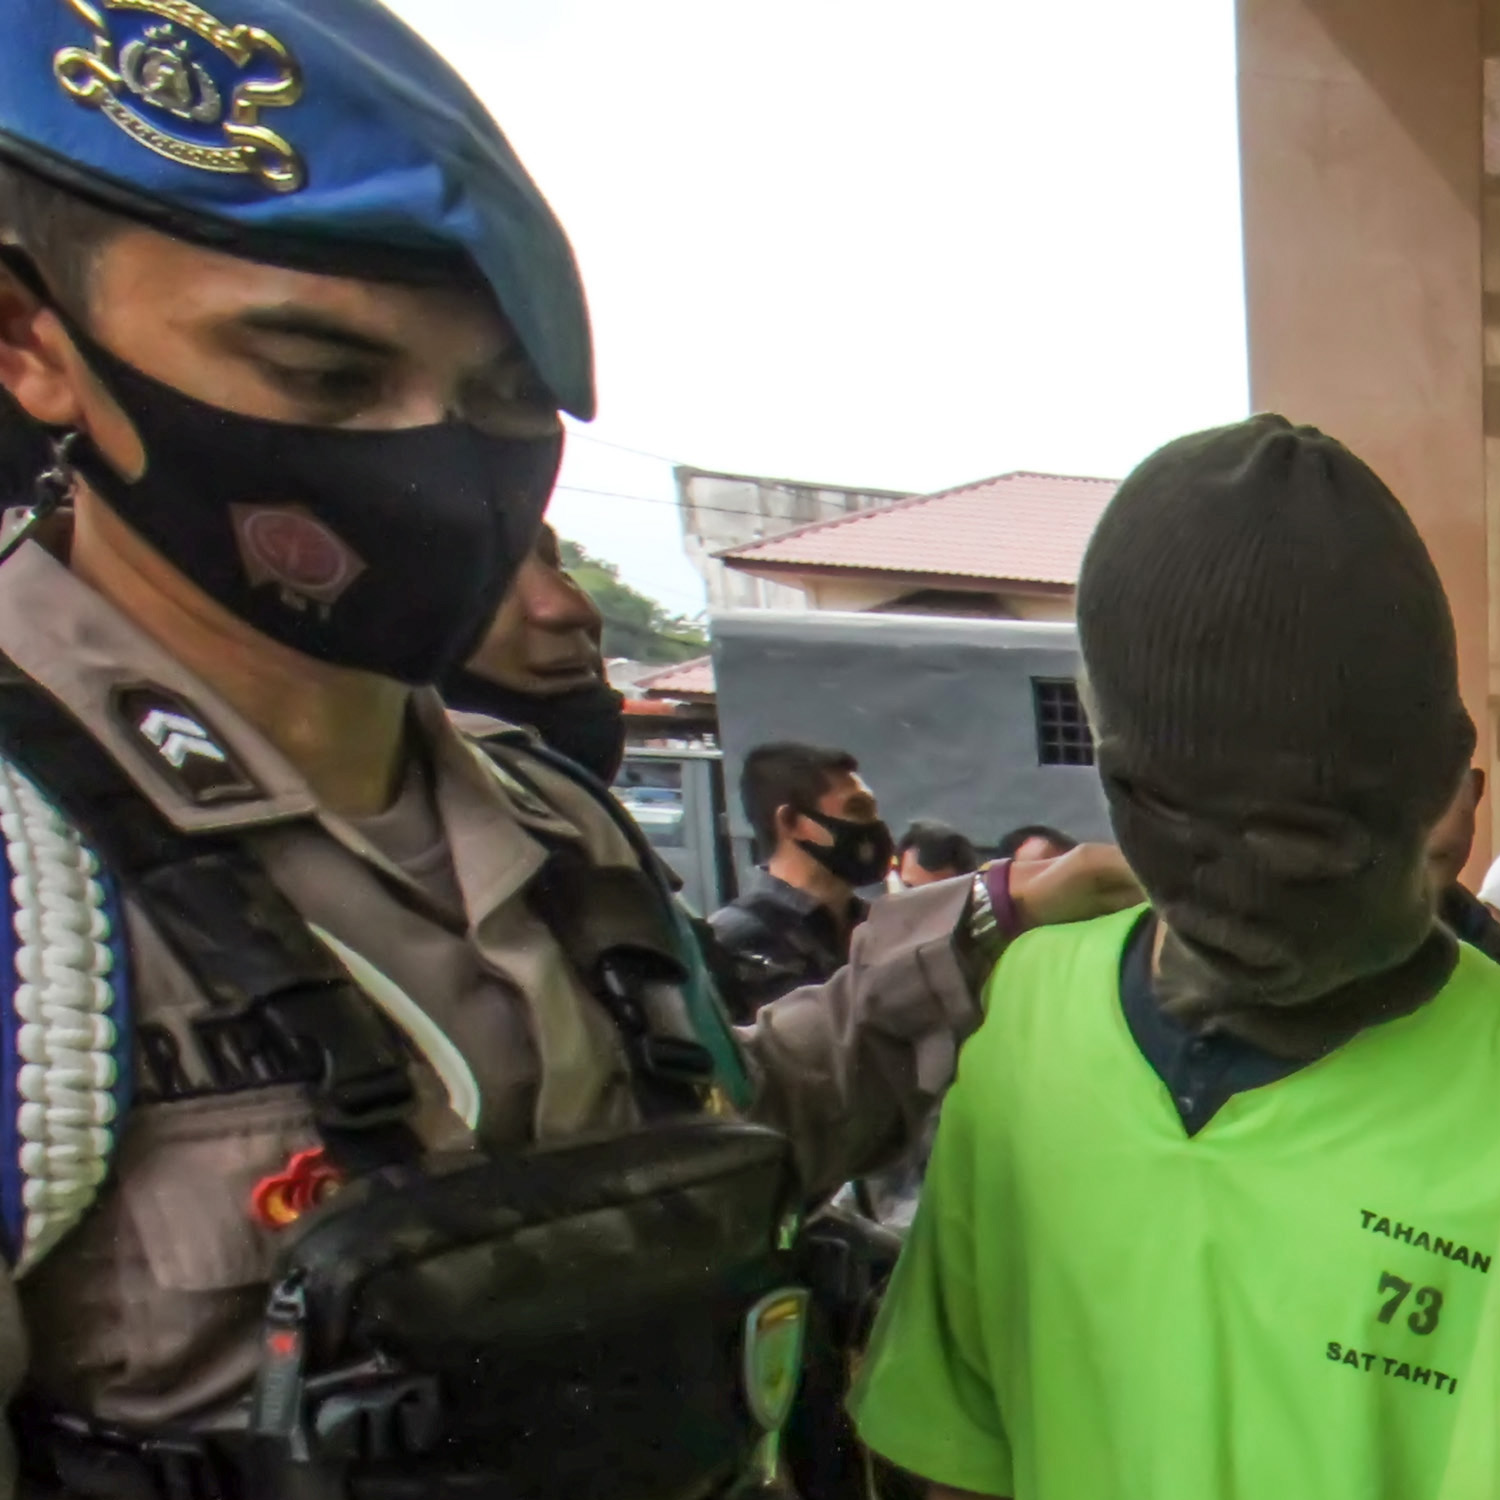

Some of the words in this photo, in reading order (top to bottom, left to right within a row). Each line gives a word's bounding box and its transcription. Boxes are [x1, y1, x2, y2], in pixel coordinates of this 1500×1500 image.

[1360, 1208, 1492, 1274] TAHANAN
[1376, 1270, 1444, 1336] 73
[1325, 1341, 1377, 1373] SAT
[1381, 1356, 1459, 1395] TAHTI
